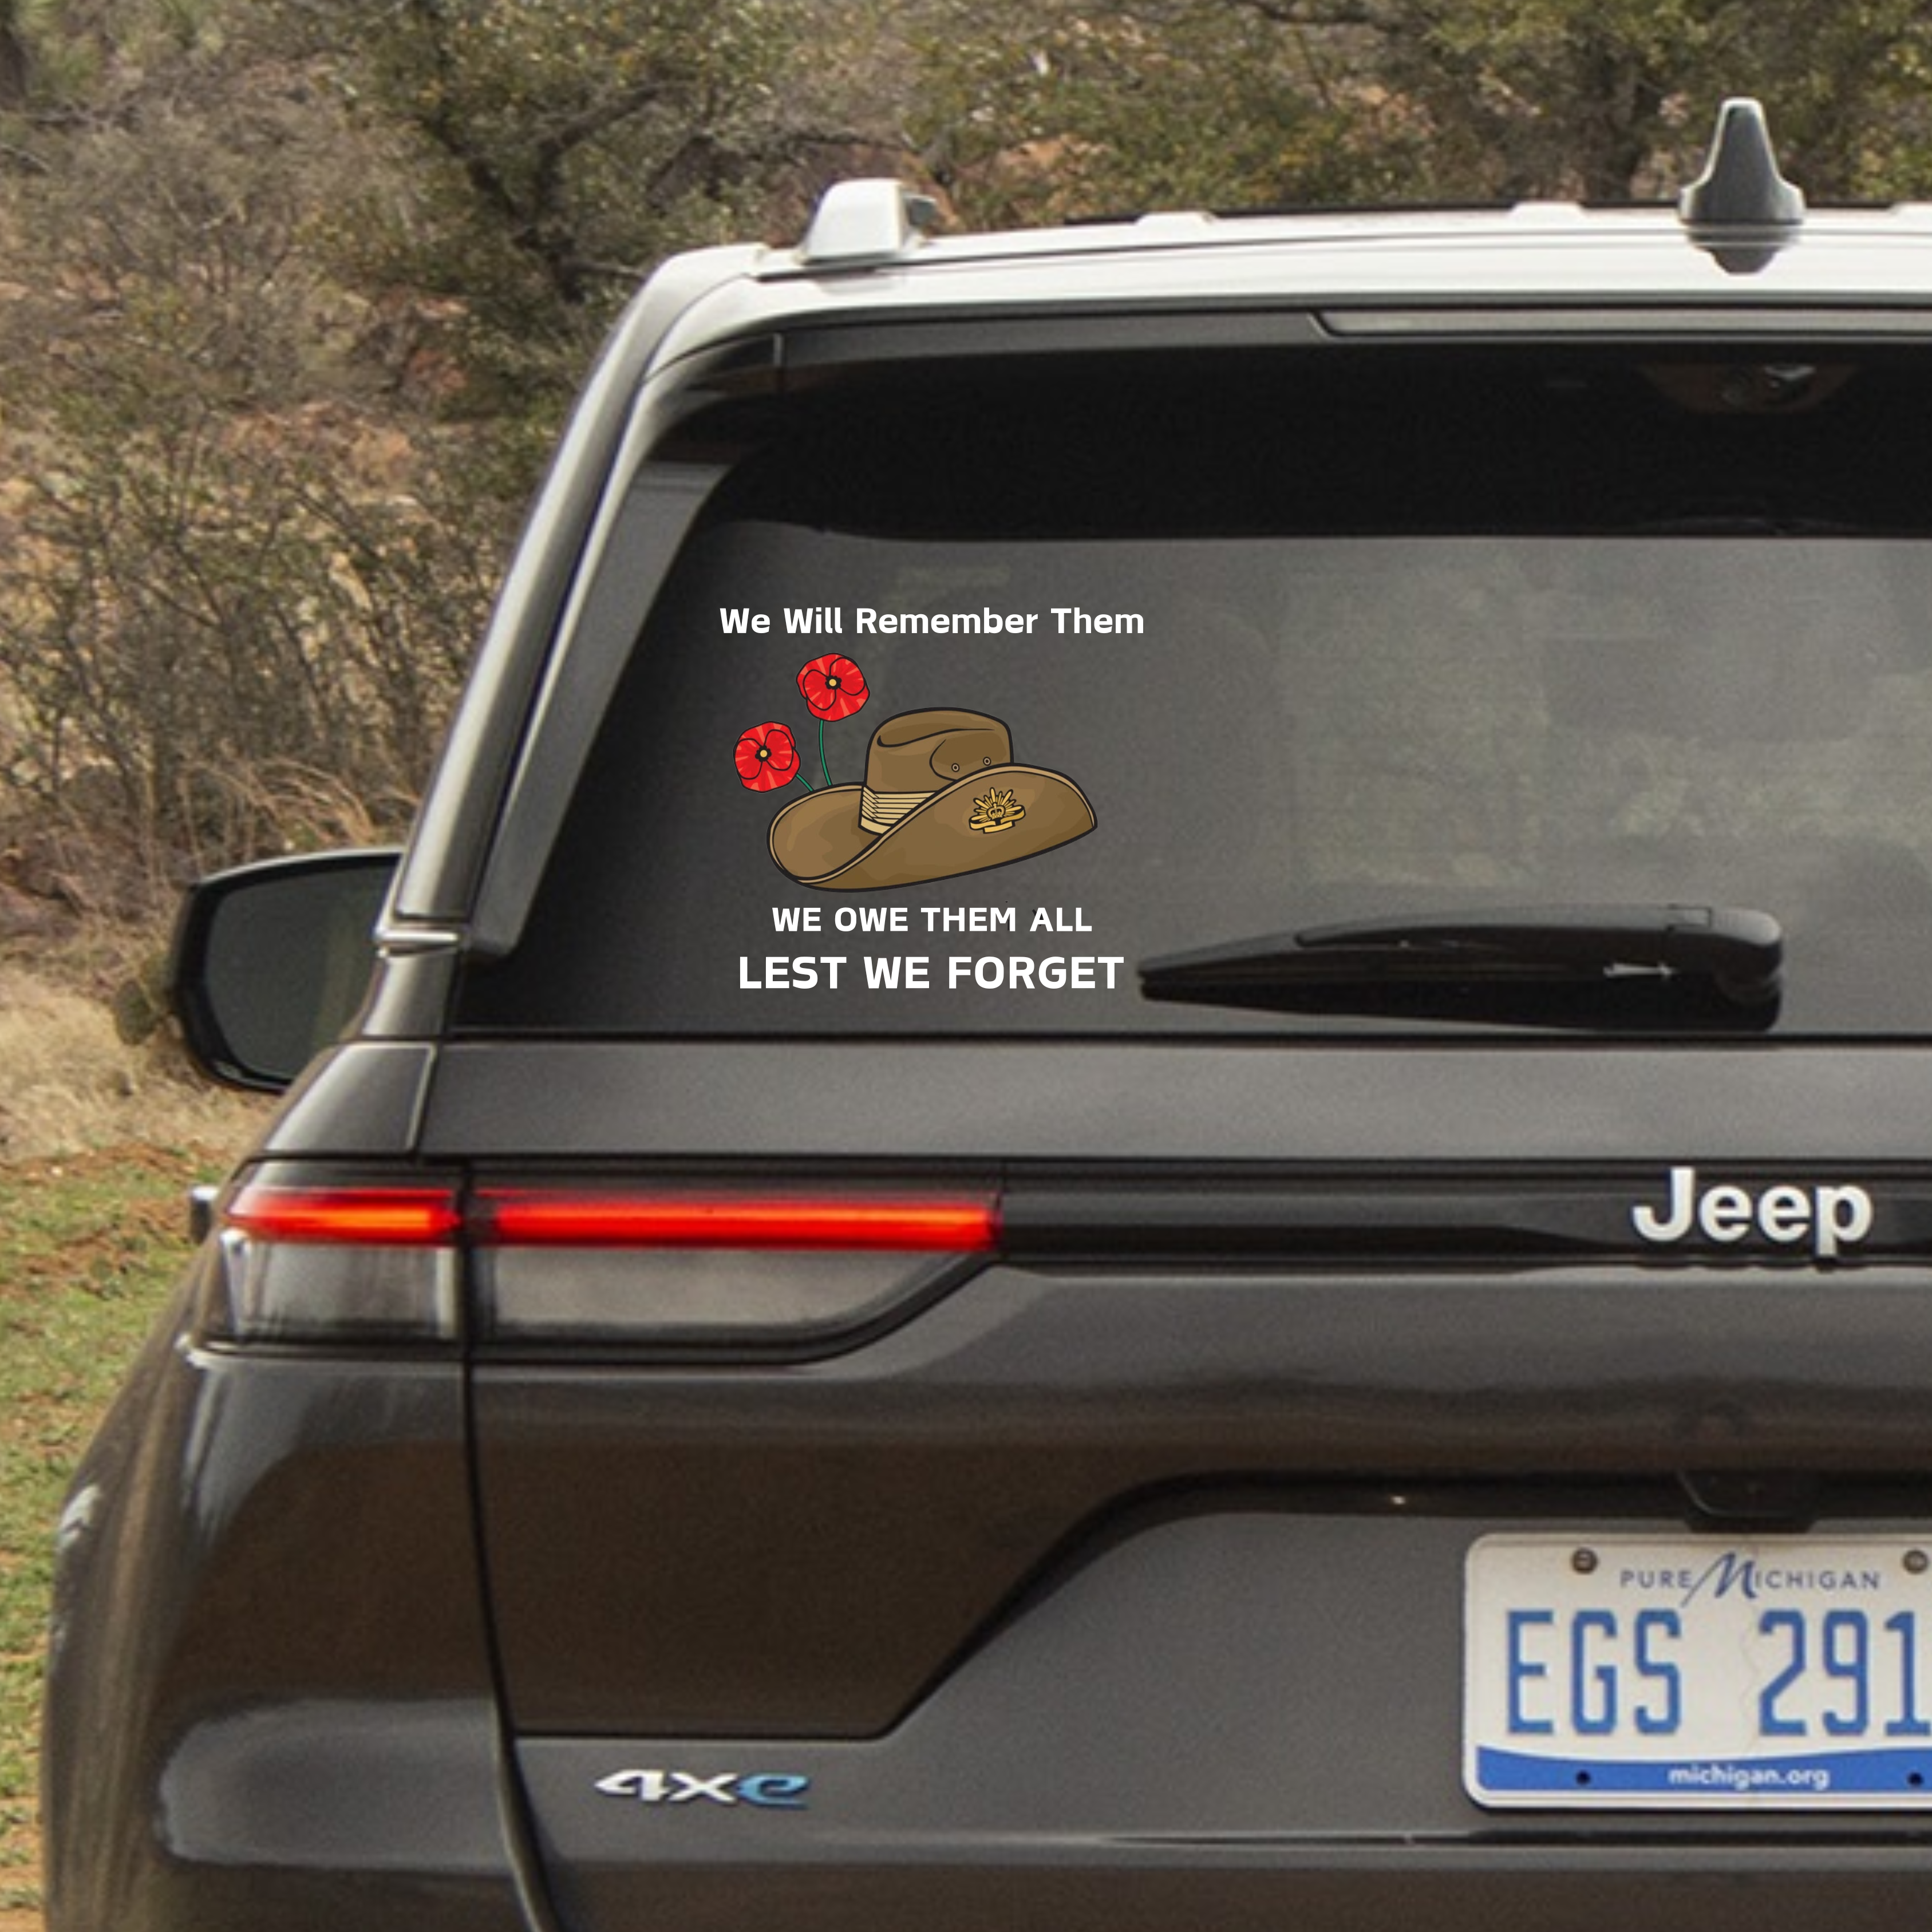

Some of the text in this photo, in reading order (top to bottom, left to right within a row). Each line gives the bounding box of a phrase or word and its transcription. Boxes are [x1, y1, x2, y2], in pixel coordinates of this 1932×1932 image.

[720, 607, 1144, 634] We Will Remember Them
[772, 907, 1092, 932] WE OWE THEM ALL
[740, 956, 1124, 989] LEST WE FORGET
[1632, 1167, 1872, 1255] Jeep
[1620, 1551, 1880, 1606] PURE MICHIGAN
[1507, 1609, 1931, 1736] EGS 291
[1668, 1763, 1831, 1790] michigan.org
